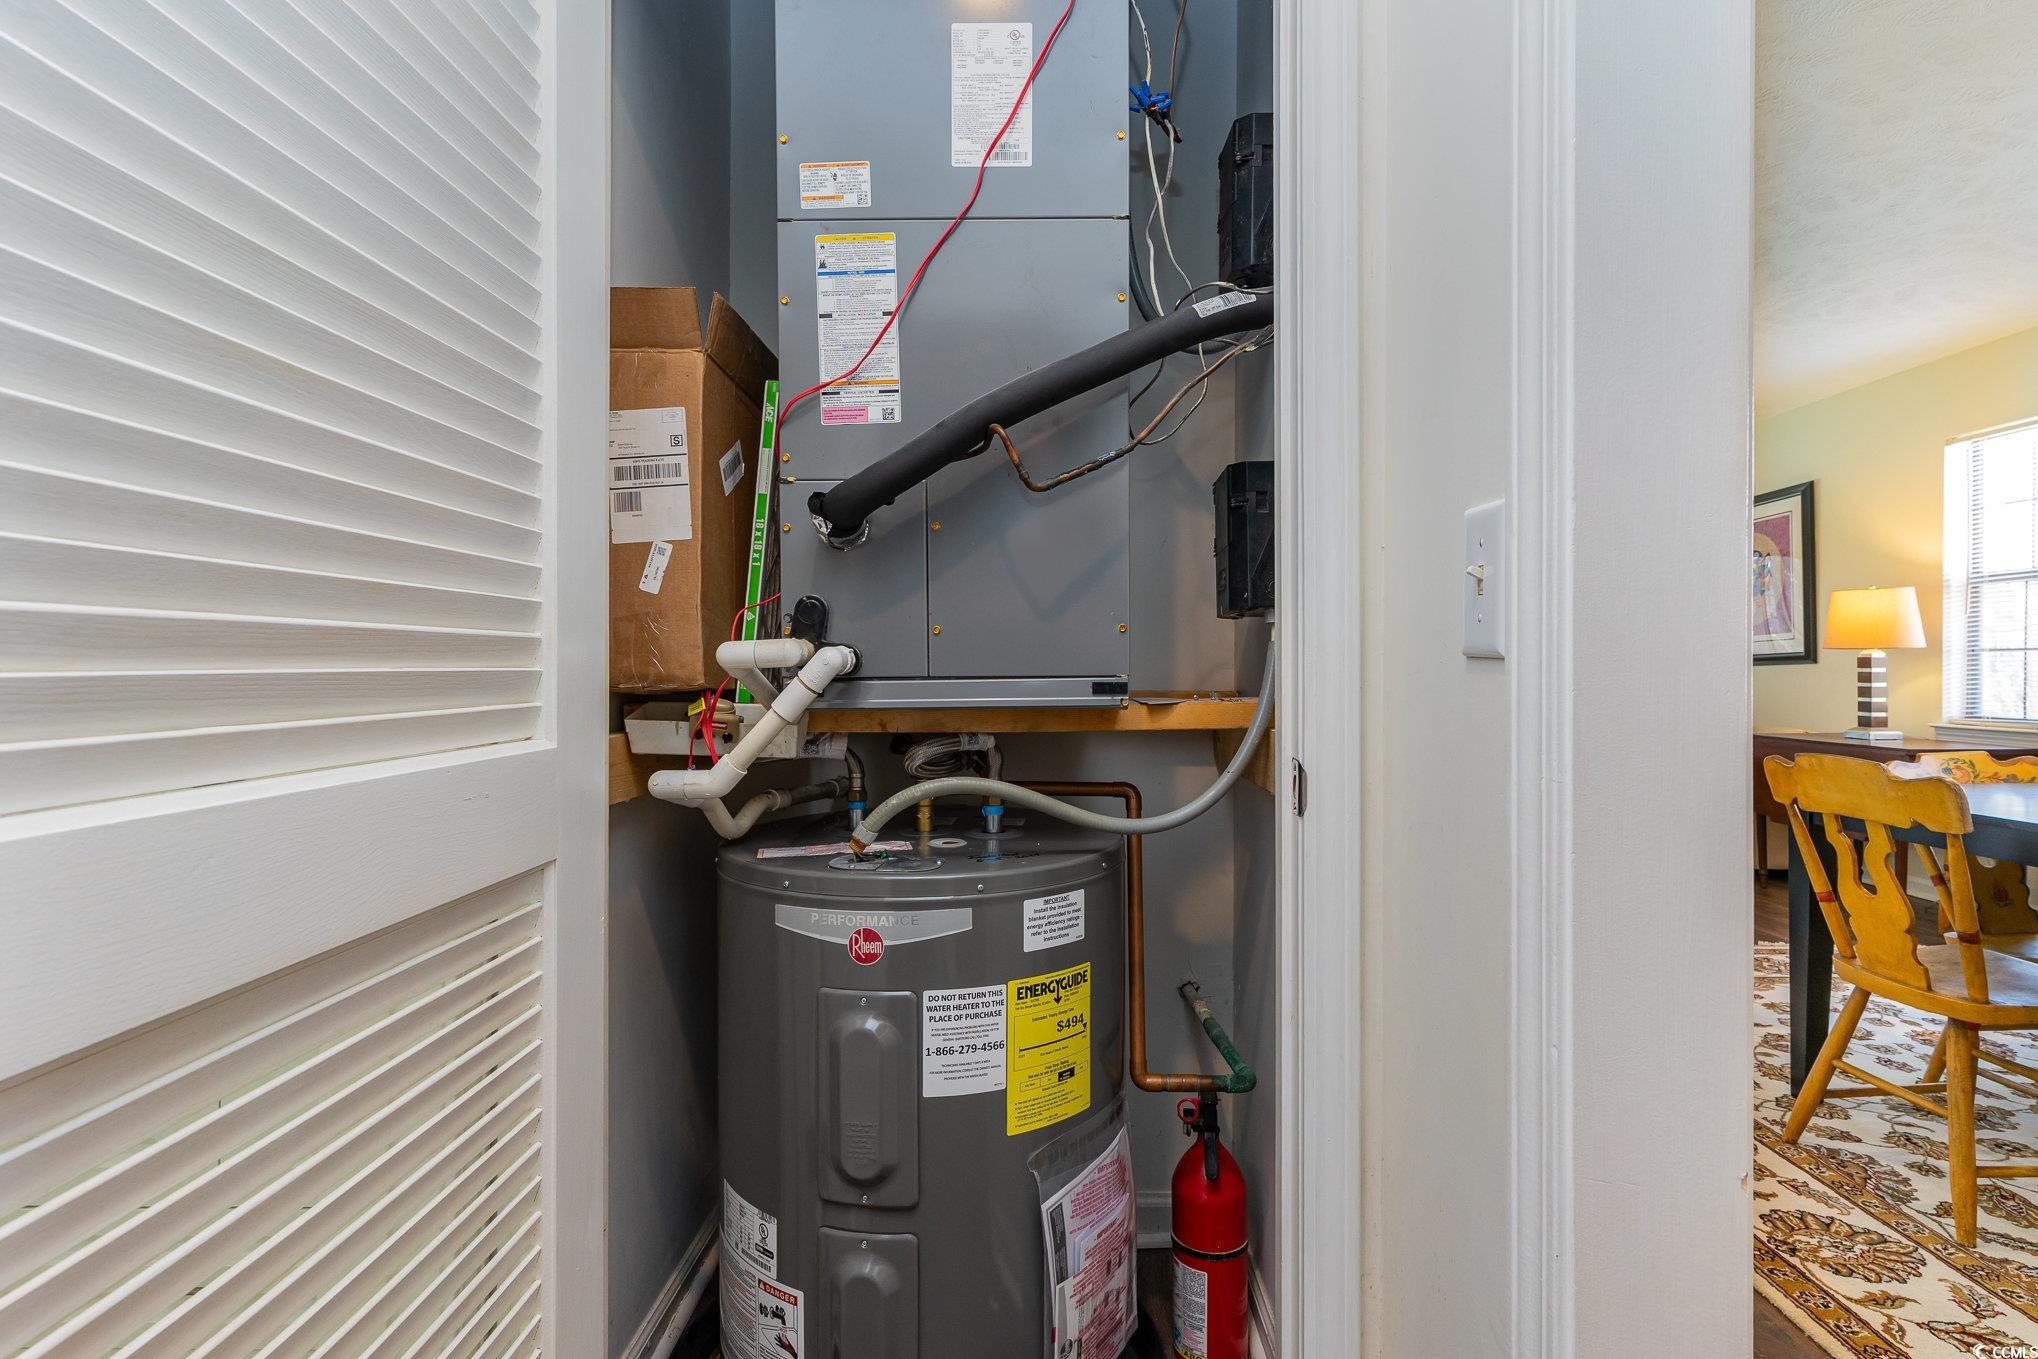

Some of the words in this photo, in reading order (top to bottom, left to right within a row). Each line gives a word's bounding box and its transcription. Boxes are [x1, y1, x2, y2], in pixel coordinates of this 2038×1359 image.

[766, 403, 774, 422] ACE
[673, 436, 680, 445] S
[756, 518, 764, 528] 18
[754, 540, 762, 550] 18
[1043, 895, 1070, 904] IMPORTANT
[811, 912, 920, 927] PERFORMANCE
[1047, 911, 1066, 920] provided
[852, 928, 882, 958] Rheem
[1017, 969, 1088, 1001] ENERGYGUIDE
[958, 992, 986, 1000] RETURN
[988, 989, 1003, 997] THIS
[953, 1002, 980, 1011] HEATER
[965, 1010, 1002, 1020] PURCHASE
[1057, 1013, 1084, 1032] $494
[925, 1040, 1004, 1056] 1-866-279-4566
[766, 1286, 795, 1304] DANGER
